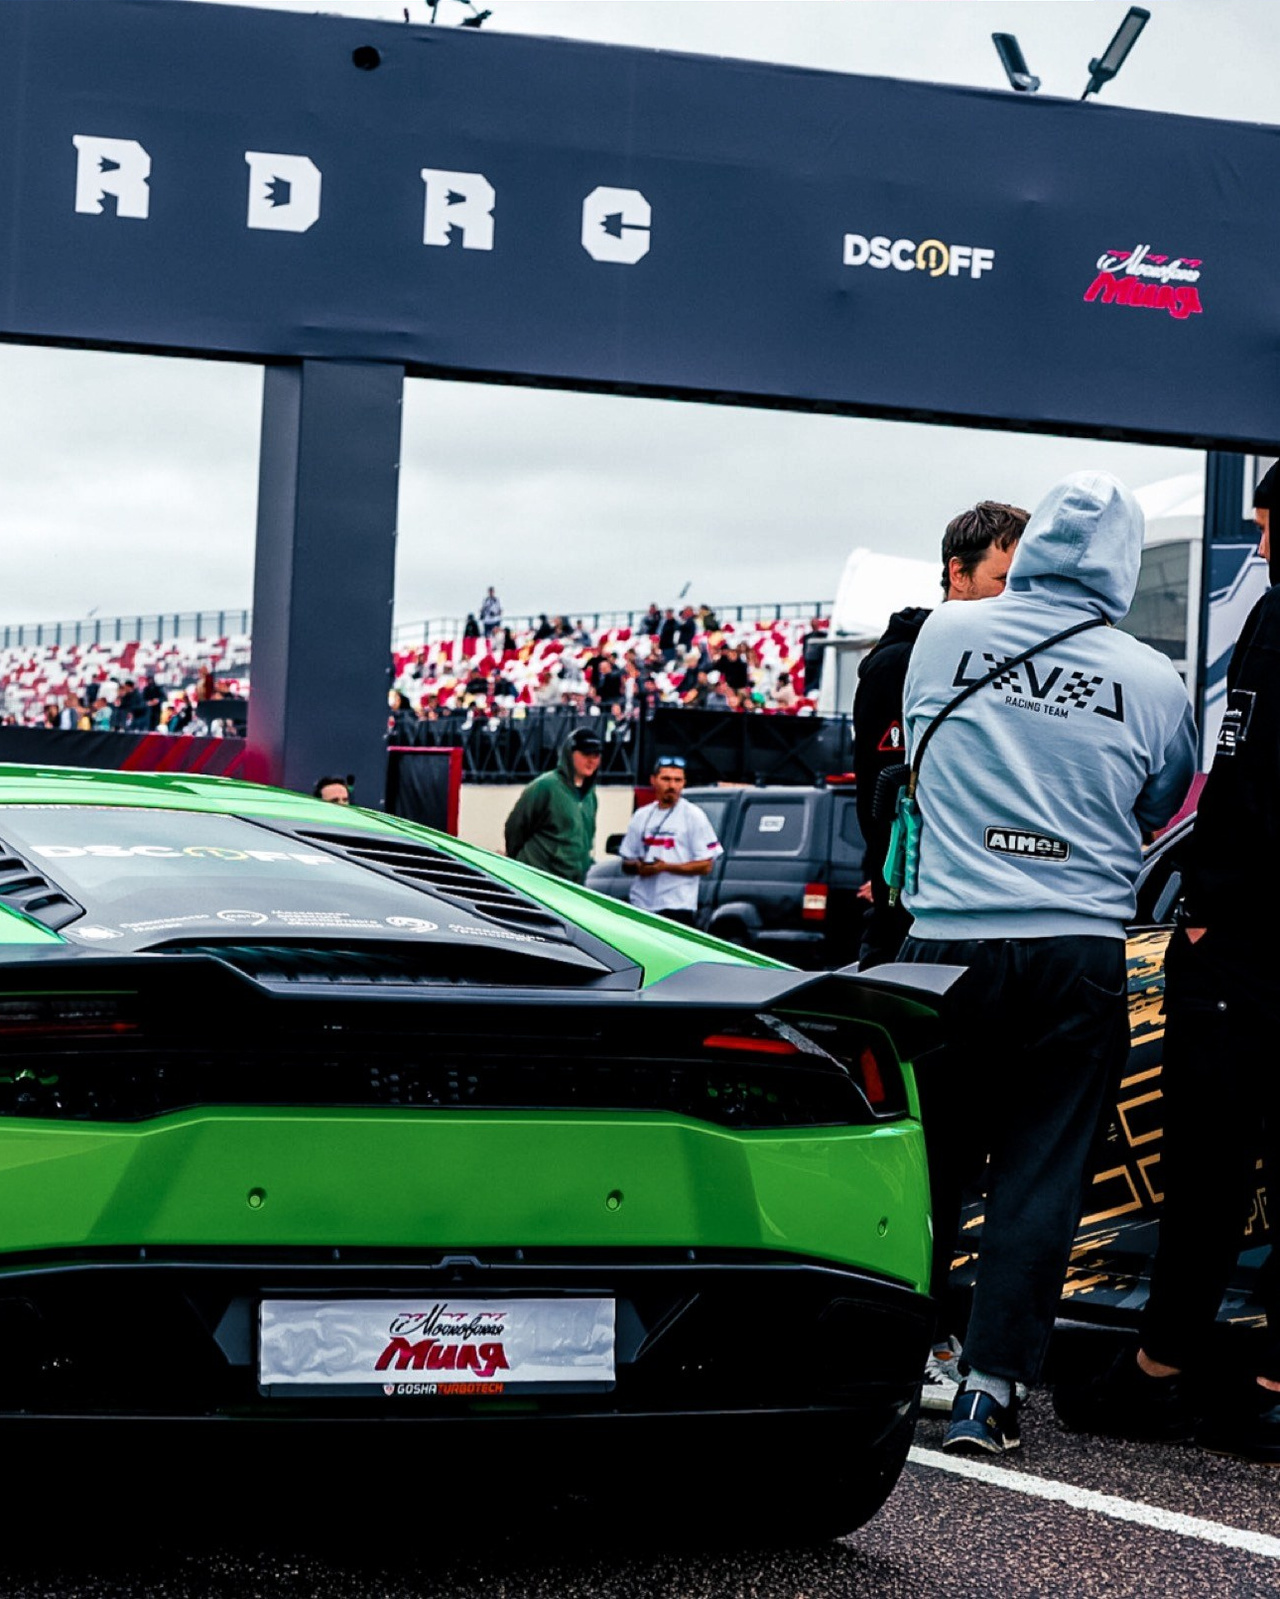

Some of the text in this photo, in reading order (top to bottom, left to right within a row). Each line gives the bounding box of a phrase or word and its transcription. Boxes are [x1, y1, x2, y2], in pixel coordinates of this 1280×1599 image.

[843, 232, 995, 279] DSCOFF
[1083, 270, 1203, 319] Миля
[1004, 695, 1069, 719] RACING TEAM
[374, 1337, 511, 1378] Миля
